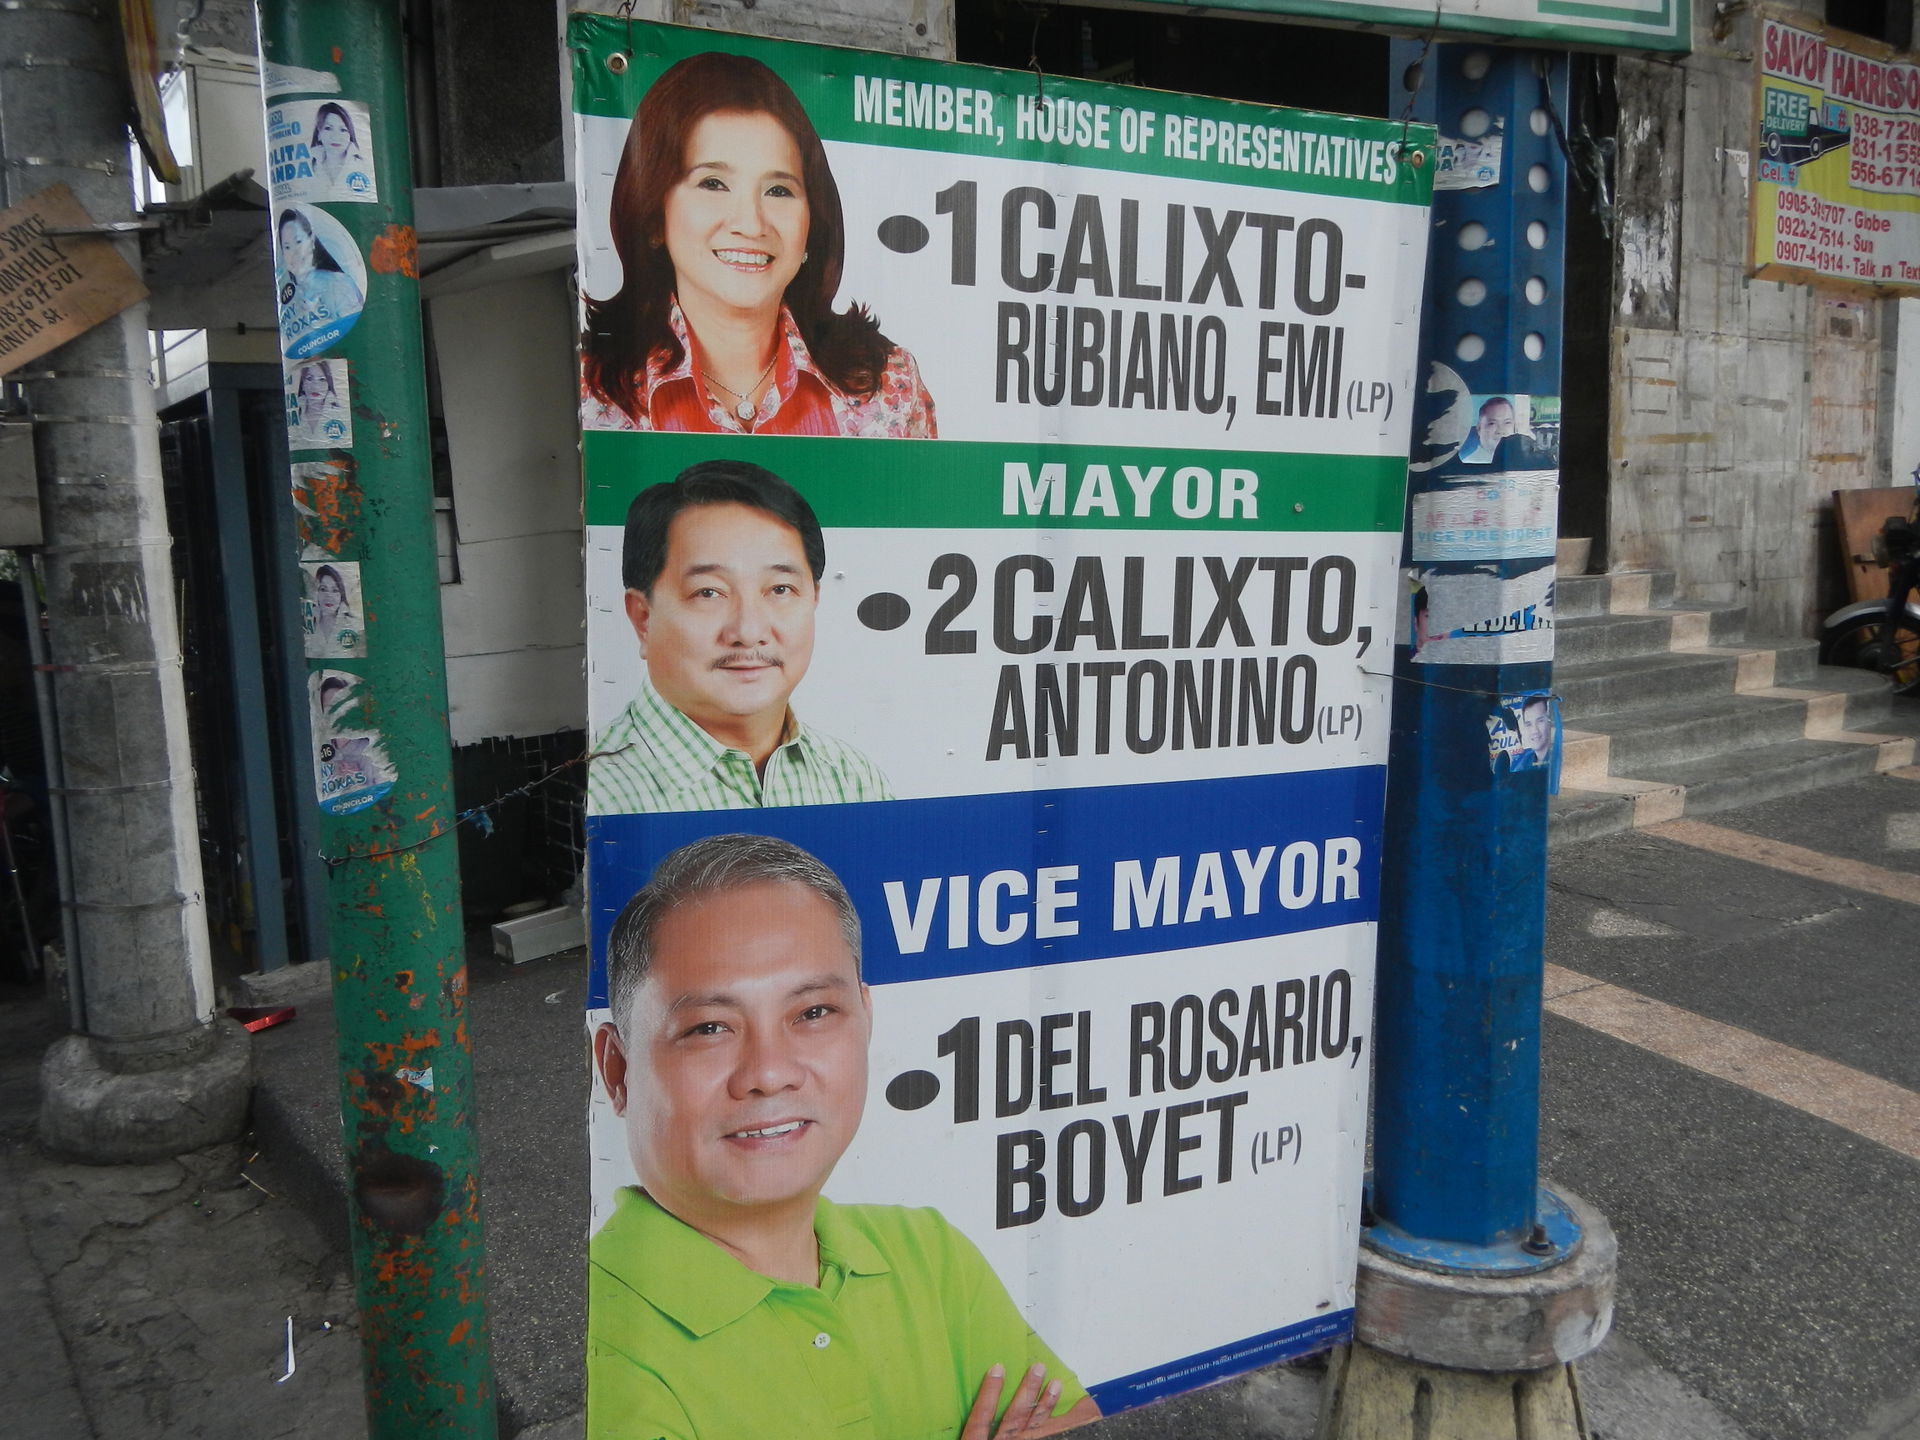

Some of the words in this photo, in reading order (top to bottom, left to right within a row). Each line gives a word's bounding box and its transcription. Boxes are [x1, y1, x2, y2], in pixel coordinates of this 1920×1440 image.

[1767, 90, 1809, 119] FREE
[1831, 52, 1920, 113] HARRISO
[853, 75, 1004, 146] MEMBER,
[1016, 94, 1109, 150] HOUSE
[1120, 107, 1154, 154] OF
[1163, 113, 1400, 185] REPRESENTATIVES
[1766, 117, 1806, 132] DELIVERY
[1761, 163, 1785, 182] Cel.
[935, 180, 977, 286] 1
[1000, 186, 1366, 316] CALIXTO-
[1853, 258, 1876, 277] Talk
[1881, 265, 1892, 278] n
[1854, 234, 1873, 253] Sun
[0, 264, 83, 330] 183697501
[286, 306, 329, 341] ROXAS
[298, 329, 340, 355] COUNCILOR
[996, 301, 1237, 431] RUBIANO,
[1256, 320, 1344, 420] EMI
[1347, 379, 1394, 423] (LP)
[1002, 461, 1259, 520] MAYOR
[924, 552, 977, 655] 2
[993, 554, 1372, 658] CALIXTO,
[985, 653, 1318, 762] ANTONINO
[1317, 702, 1363, 745] (LP)
[322, 772, 366, 794] ROXAS
[882, 864, 1079, 955] VICE
[1112, 835, 1362, 932] MAYOR
[937, 1016, 980, 1124] 1
[995, 1010, 1107, 1119] DEL
[1129, 968, 1362, 1097] ROSARIO,
[995, 1090, 1249, 1230] BOYET
[1250, 1123, 1303, 1175] (LP)
